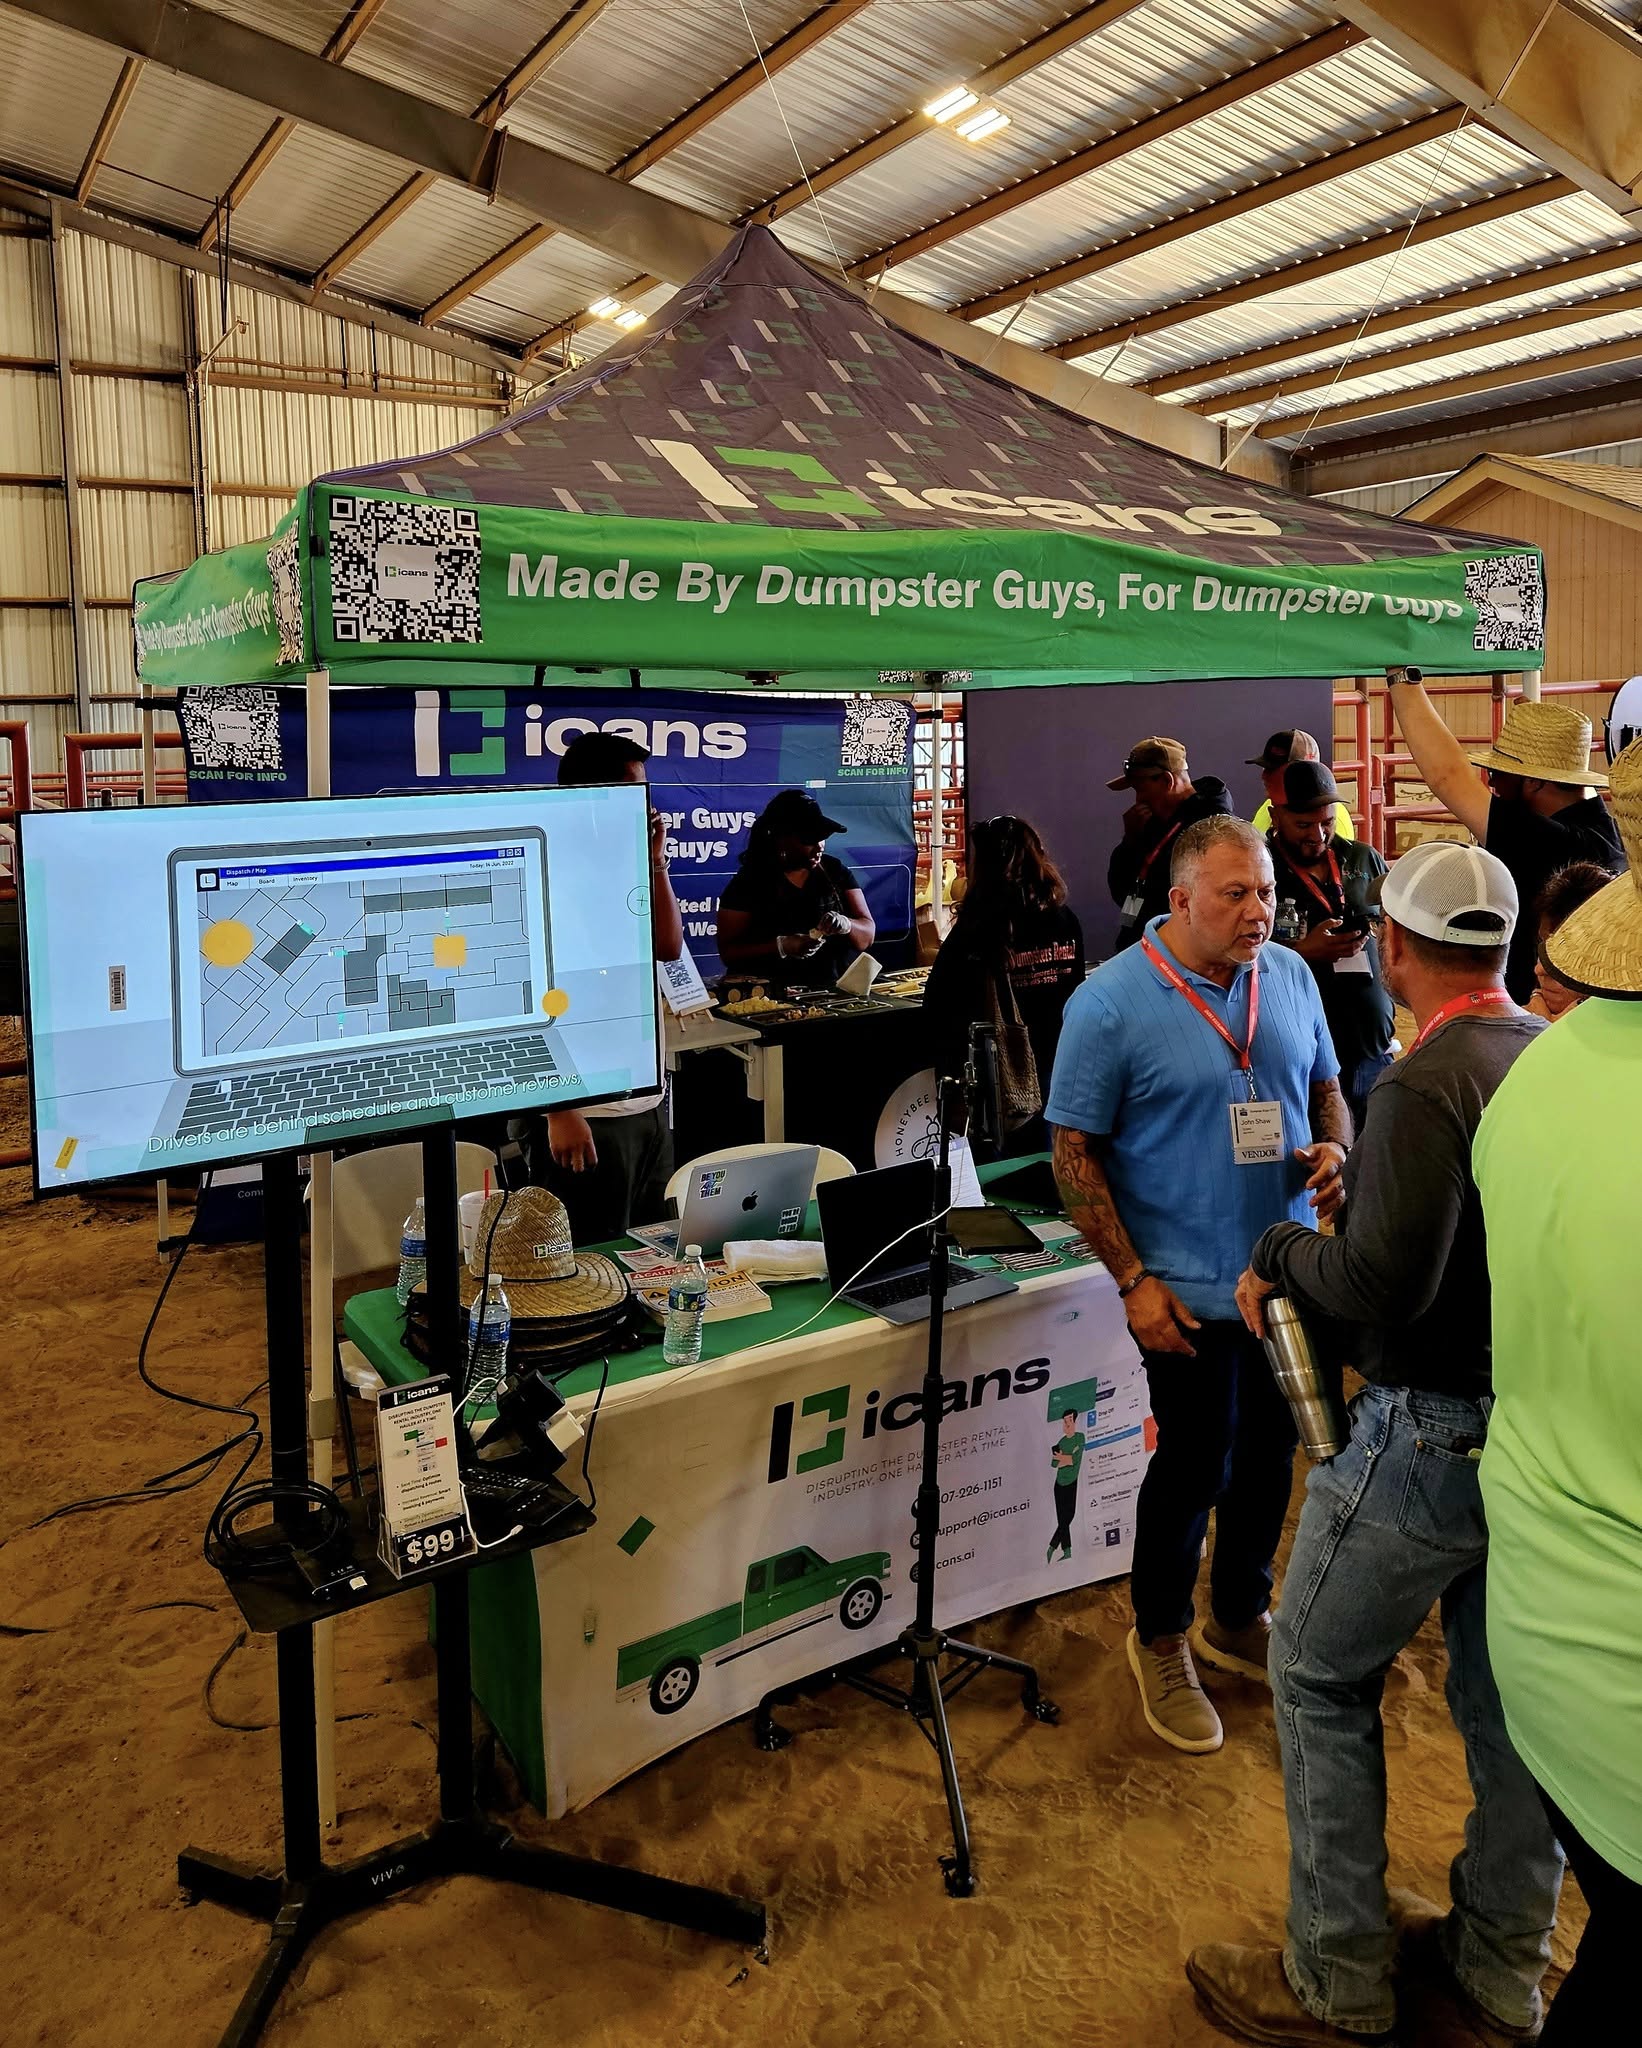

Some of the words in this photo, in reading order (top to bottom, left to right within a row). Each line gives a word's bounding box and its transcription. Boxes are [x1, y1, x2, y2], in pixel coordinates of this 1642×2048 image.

[865, 472, 1282, 535] icans
[398, 568, 428, 577] icans
[508, 553, 660, 600] Made
[677, 562, 743, 614] By
[756, 566, 980, 616] Dumpster
[993, 570, 1105, 618] Guys,
[1118, 574, 1182, 611] For
[1193, 576, 1374, 620] Dumpster
[1383, 594, 1464, 624] Guys
[244, 587, 271, 636] Guys
[188, 770, 224, 780] SCAN
[226, 772, 254, 780] FOR
[256, 772, 287, 782] INFO
[886, 768, 908, 776] INFO
[692, 808, 756, 834] Guys
[664, 837, 728, 864] Guys
[1053, 940, 1076, 960] Rental
[148, 1129, 212, 1152] Drivers
[216, 1126, 248, 1143] are
[254, 1112, 318, 1136] behind
[322, 1100, 402, 1126] schedule
[406, 1093, 440, 1112] and
[445, 1082, 518, 1105] customer
[522, 1073, 582, 1094] reviews,
[895, 1094, 929, 1156] HONEYBEE
[1242, 1150, 1278, 1158] VENDOR
[701, 1173, 711, 1182] BE
[712, 1170, 726, 1180] YOU
[700, 1187, 721, 1198] THEM
[408, 1386, 439, 1400] icans
[862, 1357, 1050, 1439] icans
[806, 1463, 878, 1494] DISRUPTING
[881, 1456, 904, 1470] THE
[908, 1437, 968, 1462] DUSTER
[971, 1425, 1010, 1442] RENTAL
[813, 1478, 874, 1504] INDUSTRY,
[879, 1468, 902, 1482] ONE
[907, 1454, 951, 1472] HAER
[956, 1449, 968, 1460] AT
[970, 1446, 978, 1456] A
[981, 1438, 1006, 1452] TIME
[939, 1476, 1002, 1504] 07-226-1151
[936, 1499, 1030, 1536] upport@icans.ai
[406, 1530, 454, 1564] $99
